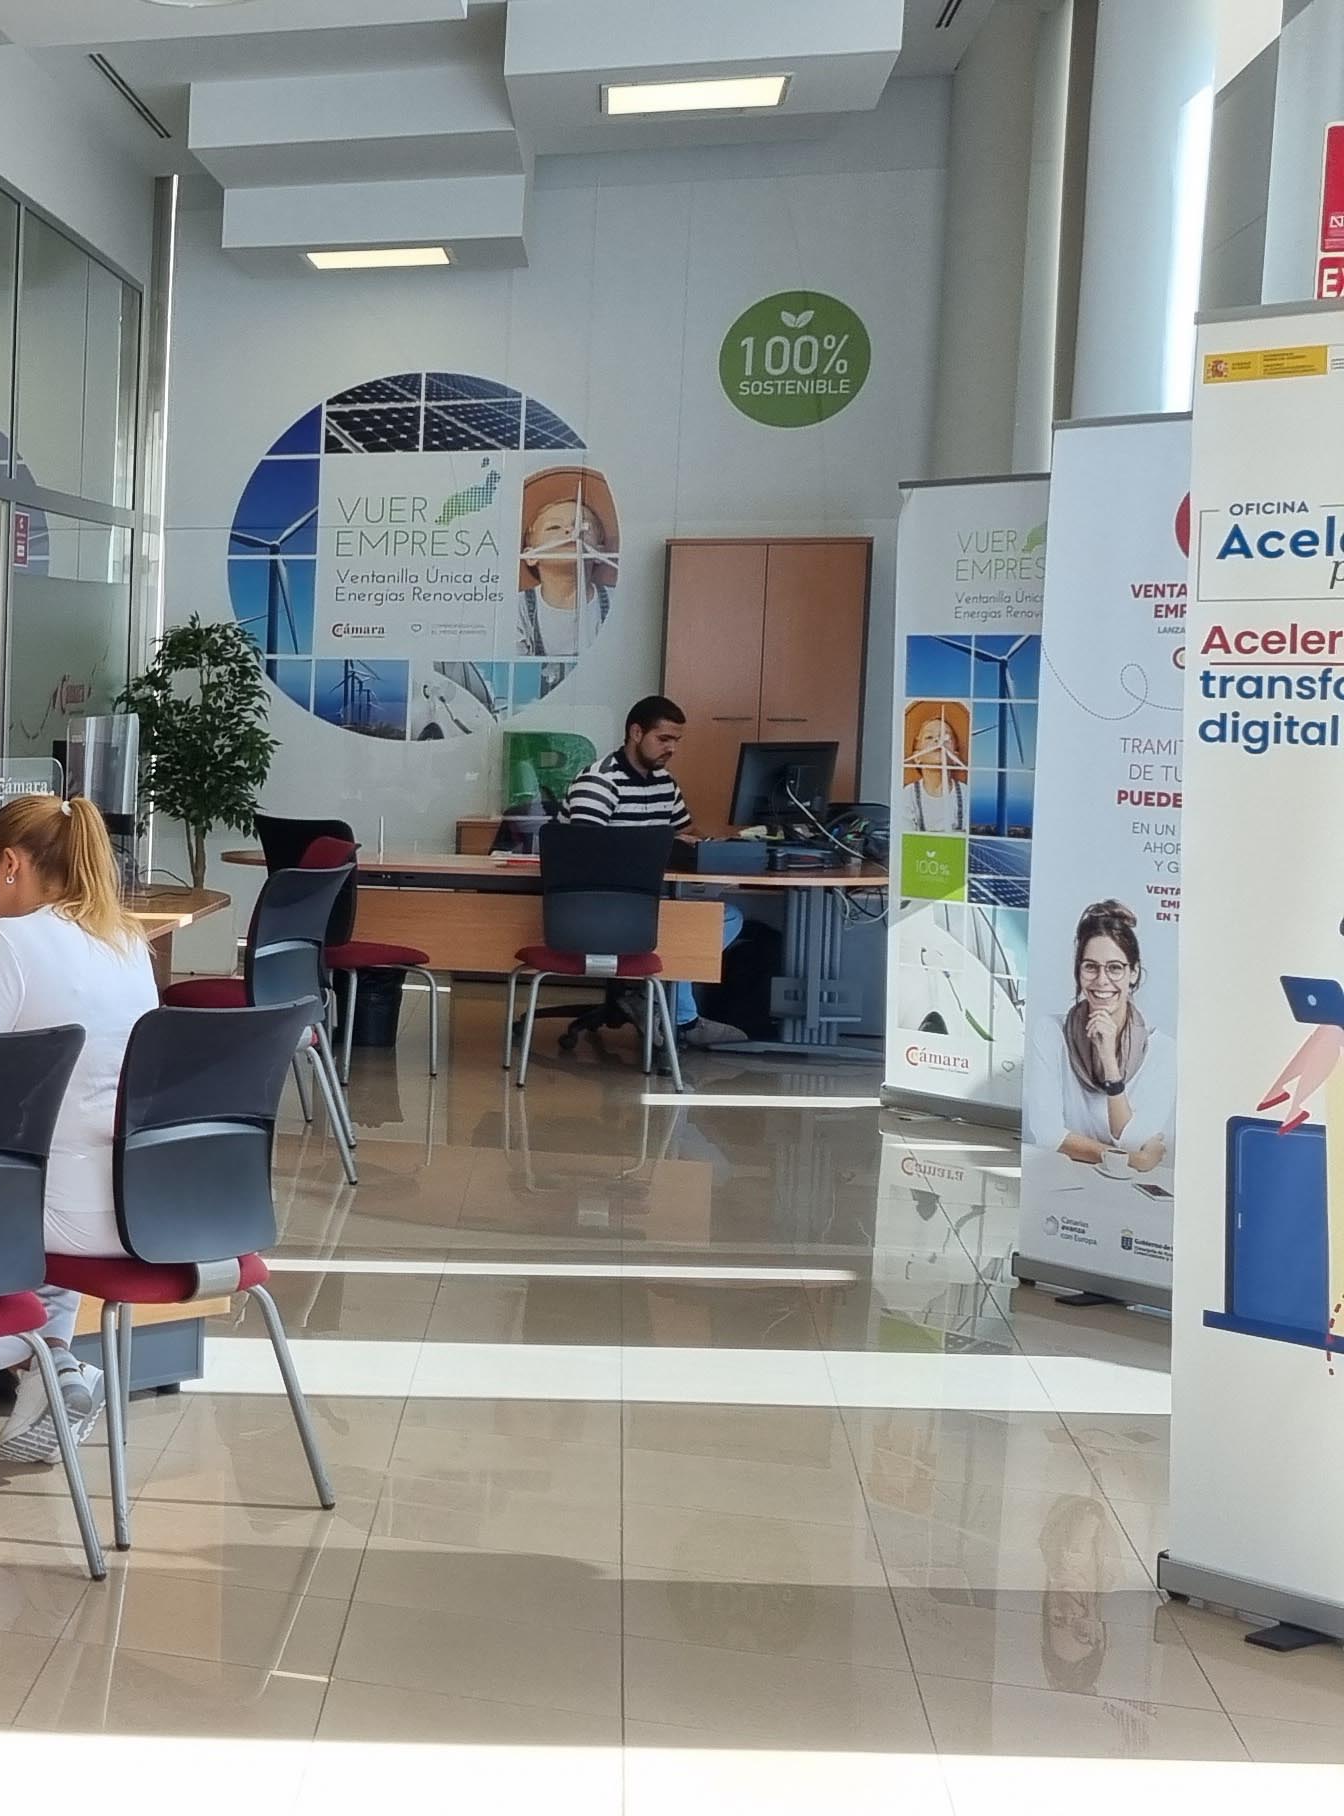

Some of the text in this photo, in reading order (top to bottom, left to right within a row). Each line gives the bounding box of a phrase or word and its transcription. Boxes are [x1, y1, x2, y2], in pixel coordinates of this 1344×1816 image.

[740, 334, 850, 377] 100%
[738, 379, 851, 395] SOSTENIBLE
[337, 496, 428, 524] VUER
[1229, 501, 1309, 516] OFICINA
[335, 530, 500, 557] EMPRESA
[957, 529, 1018, 554] VUER
[1216, 515, 1344, 559] Acel
[336, 565, 500, 584] Ventanilla Única de
[335, 585, 504, 606] Energías Renovables
[331, 623, 385, 637] Cámara
[1198, 711, 1339, 755] digital
[1128, 763, 1154, 781] DE
[1132, 821, 1176, 836] EN UN
[1154, 860, 1164, 872] Y
[905, 1046, 969, 1069] Cámara
